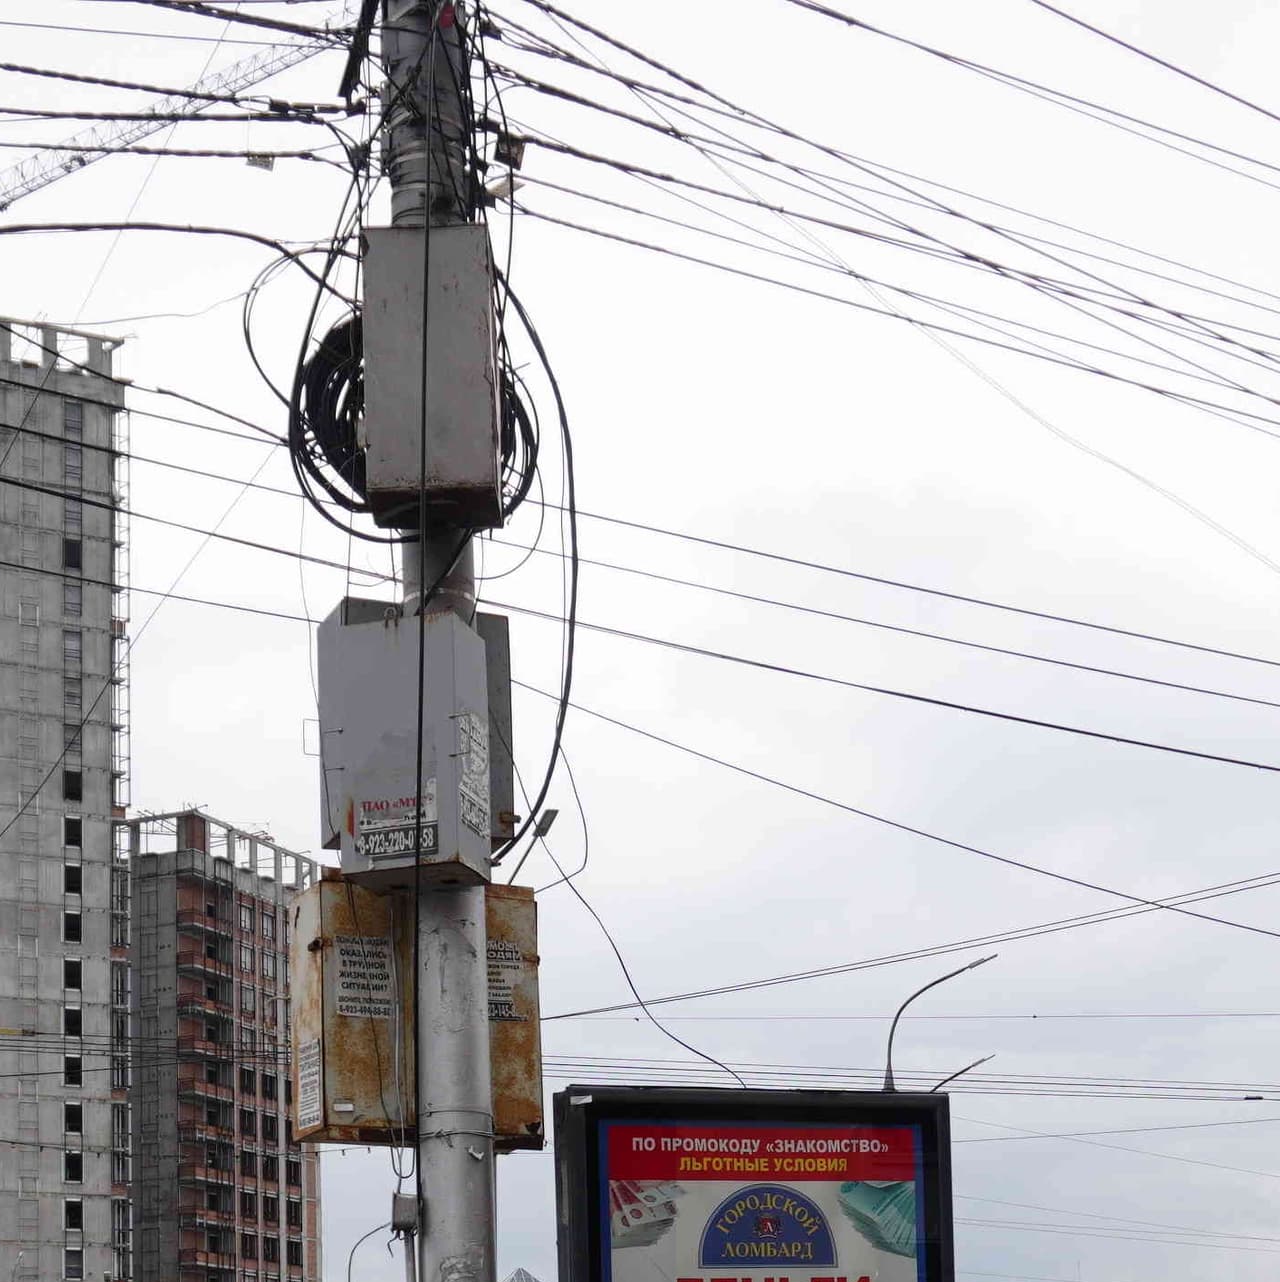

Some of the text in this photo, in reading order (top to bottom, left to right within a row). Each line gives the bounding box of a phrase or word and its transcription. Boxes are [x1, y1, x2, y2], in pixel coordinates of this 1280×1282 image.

[362, 801, 389, 812] ПАО
[632, 1137, 889, 1155] ПО ПРОМОКОДУ «ЗНАКОМСТВО»
[679, 1156, 848, 1172] ЛЬГОТНЫЕ УСЛОВИЯ
[716, 1191, 822, 1236] ГОРОДСКОЙ
[721, 1241, 814, 1260] ЛОМБАРД
